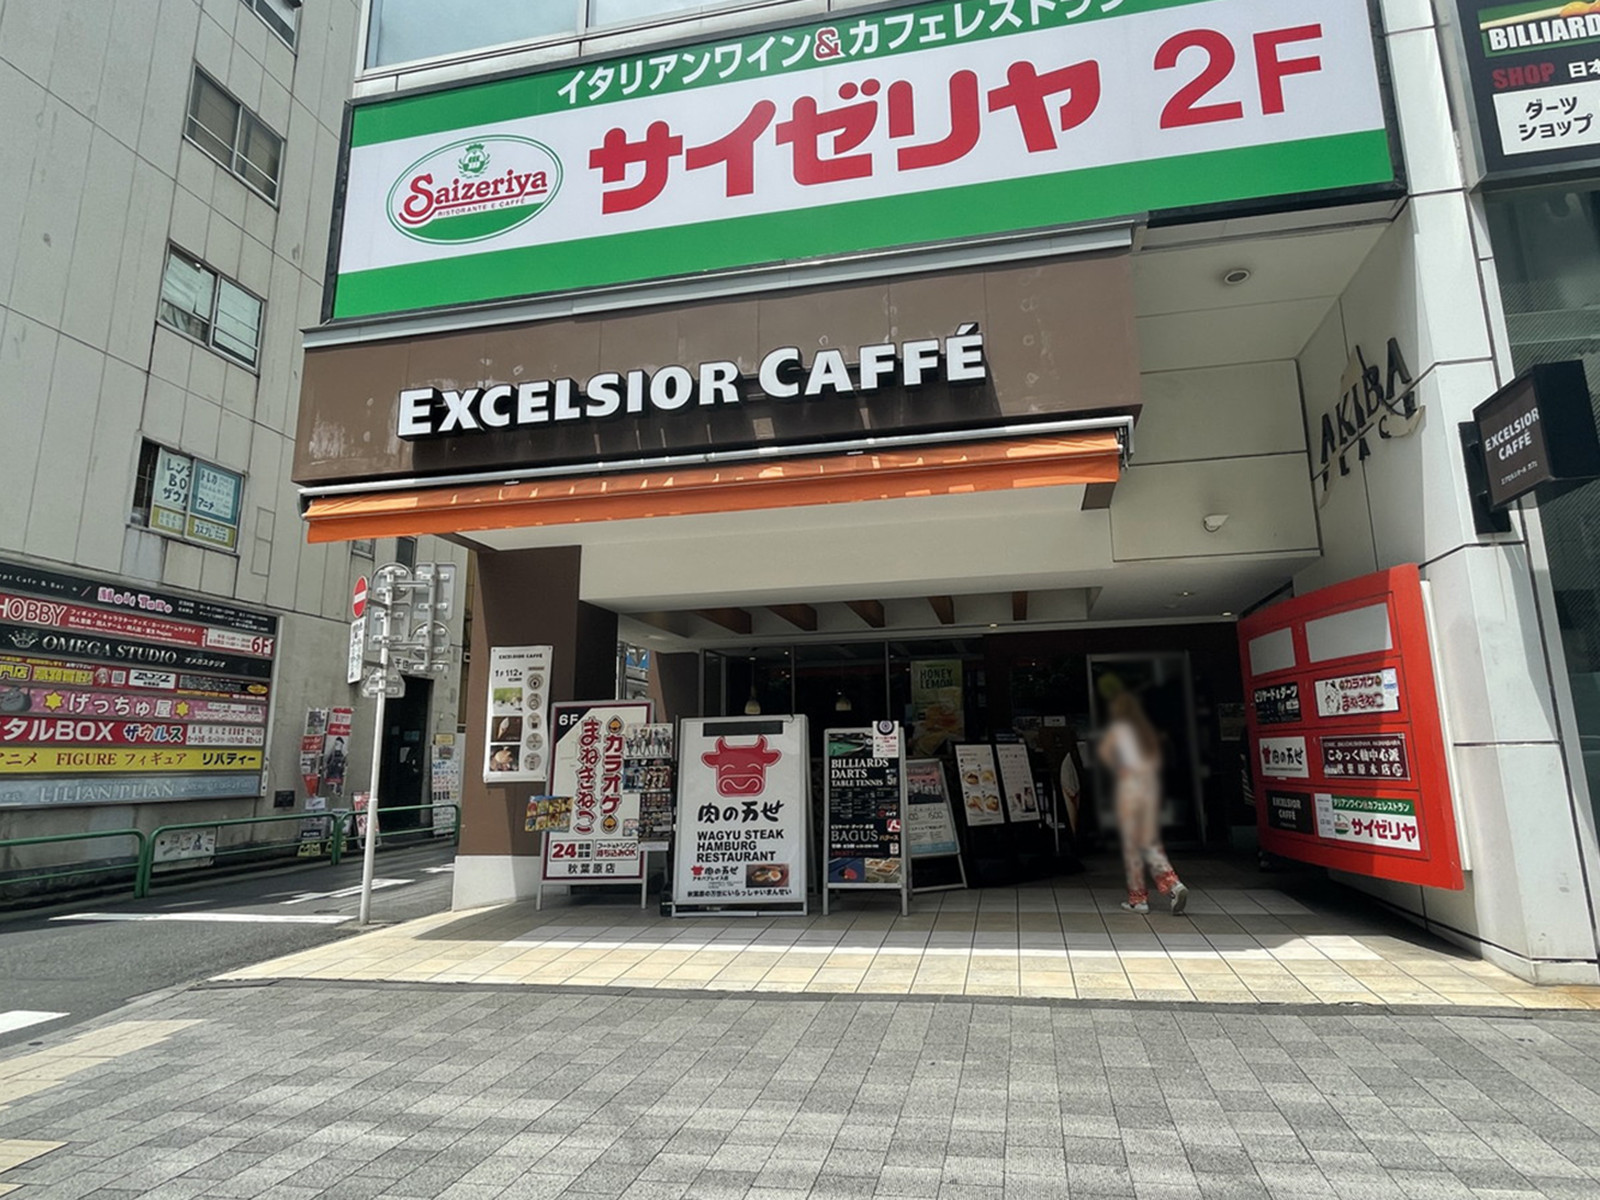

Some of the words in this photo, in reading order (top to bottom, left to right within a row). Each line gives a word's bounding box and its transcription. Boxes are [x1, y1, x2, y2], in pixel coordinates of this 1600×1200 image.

[1492, 62, 1556, 89] SHOP
[1525, 96, 1578, 120] ダーツ
[588, 59, 1101, 215] サイゼリヤ
[1153, 23, 1323, 130] 2F
[1518, 113, 1594, 142] ショップ
[398, 169, 548, 224] Saizeriya
[437, 204, 488, 217] RISTORANTE
[397, 361, 740, 438] EXCELSIOR
[758, 322, 987, 399] CAFFÉ
[1320, 338, 1412, 464] AKIBA
[1484, 407, 1540, 452] EXCELSIOR
[1498, 429, 1532, 461] CAFFÉ
[42, 635, 111, 656] OMEGA
[116, 644, 177, 664] STUDIO
[920, 669, 952, 678] HONEY
[920, 679, 952, 689] LEMON
[1343, 675, 1375, 690] カラオケ
[68, 693, 172, 717] げっちゅ屋
[1342, 692, 1384, 712] まねきねこ
[559, 714, 579, 726] 6F
[123, 723, 183, 743] ザウルス
[56, 752, 118, 766] FIGURE
[125, 752, 187, 766] フィギュア
[202, 752, 256, 766] リバティー
[831, 758, 889, 768] BILLIARDS
[574, 717, 602, 833] まねきねこ
[601, 734, 624, 815] カラオケ
[831, 769, 868, 779] DARTS
[831, 779, 854, 787] TABLE
[855, 778, 884, 786] TENNIS
[39, 785, 113, 802] LILIAN
[1272, 797, 1301, 809] EXCELSIOR
[697, 830, 741, 842] WAGYU
[744, 829, 784, 841] STEAK
[831, 830, 879, 841] BAGUS
[1351, 818, 1417, 842] サイゼリヤ
[552, 843, 577, 858] 24
[697, 840, 757, 853] HAMBURG
[696, 851, 776, 864] RESTAURANT
[567, 863, 616, 874] 秋葉原店
